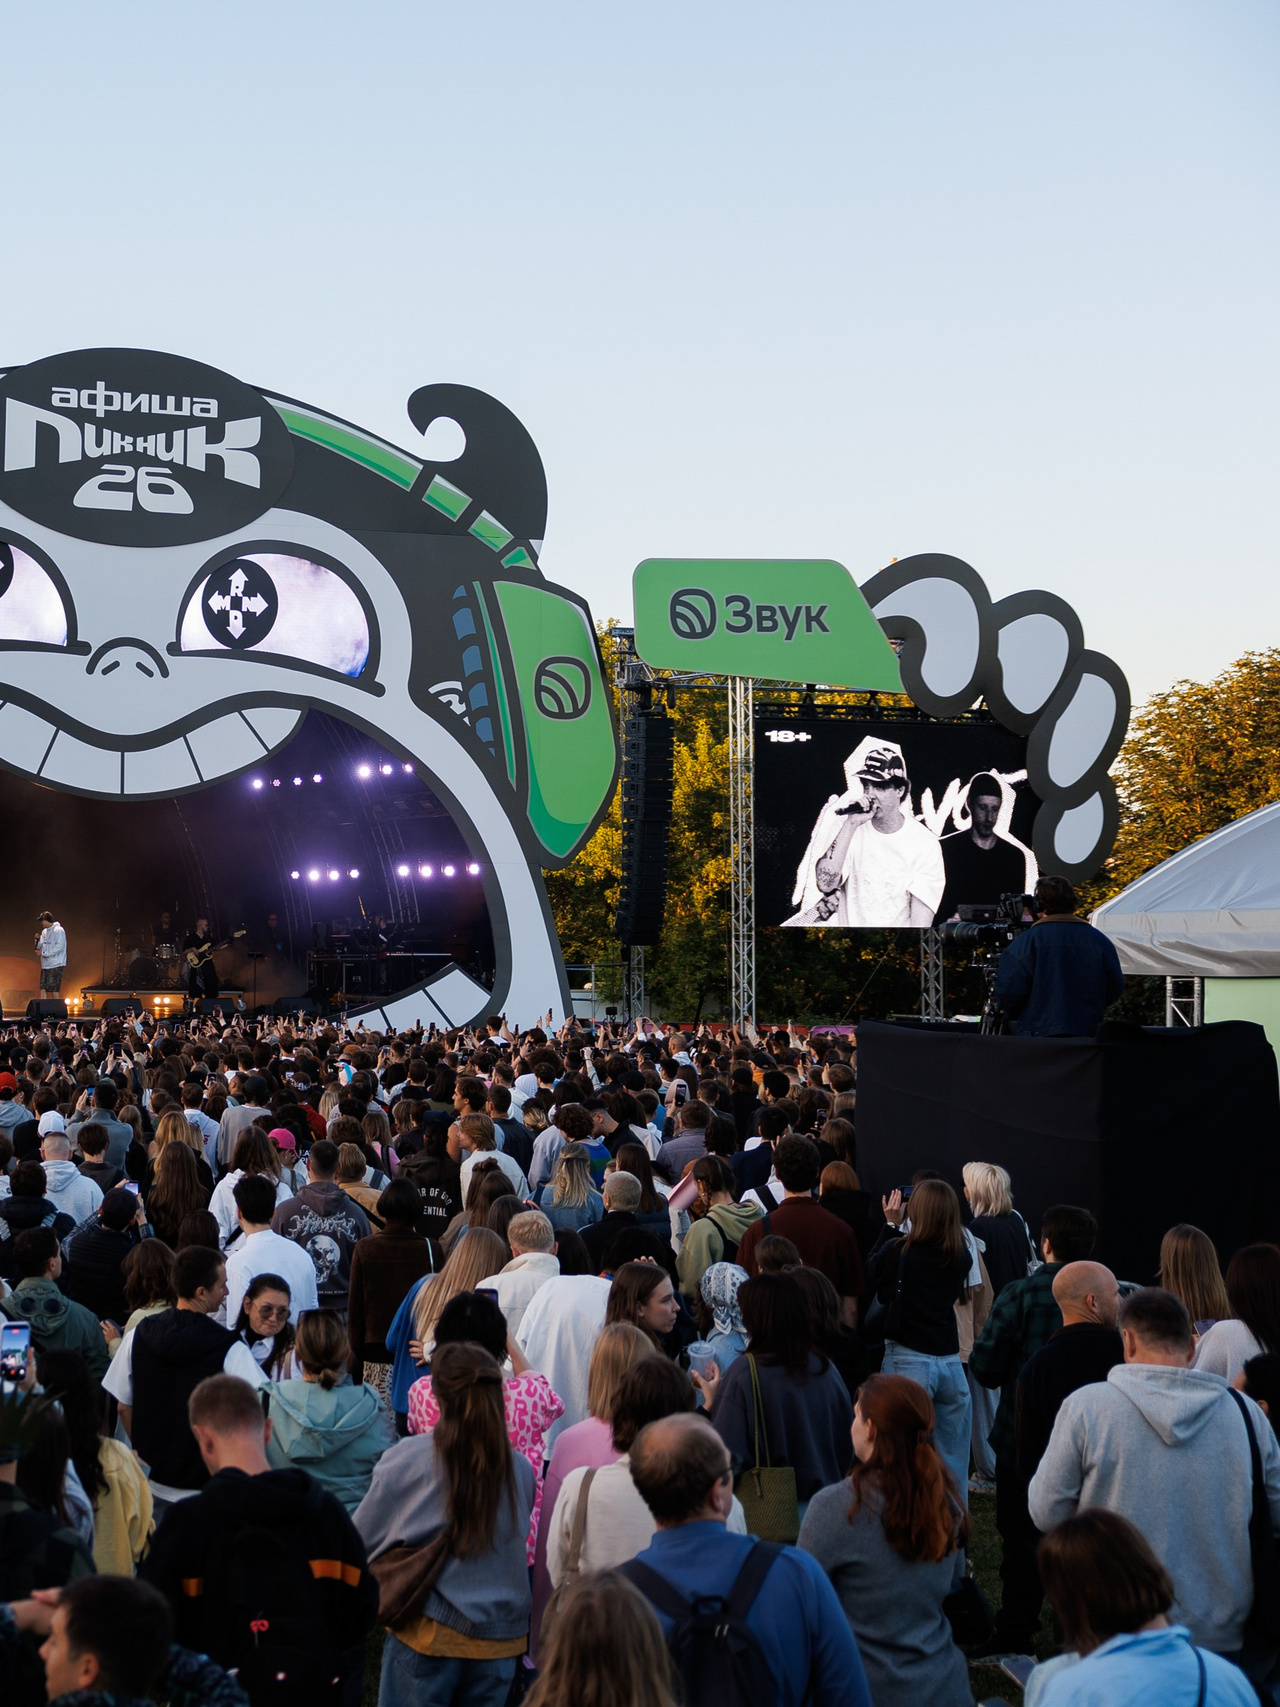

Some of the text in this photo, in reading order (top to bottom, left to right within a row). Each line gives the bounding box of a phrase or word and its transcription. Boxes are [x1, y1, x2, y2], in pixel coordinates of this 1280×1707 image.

[51, 381, 218, 418] афиша
[73, 464, 194, 514] 26
[725, 594, 830, 641] Звук
[764, 730, 812, 743] 18+
